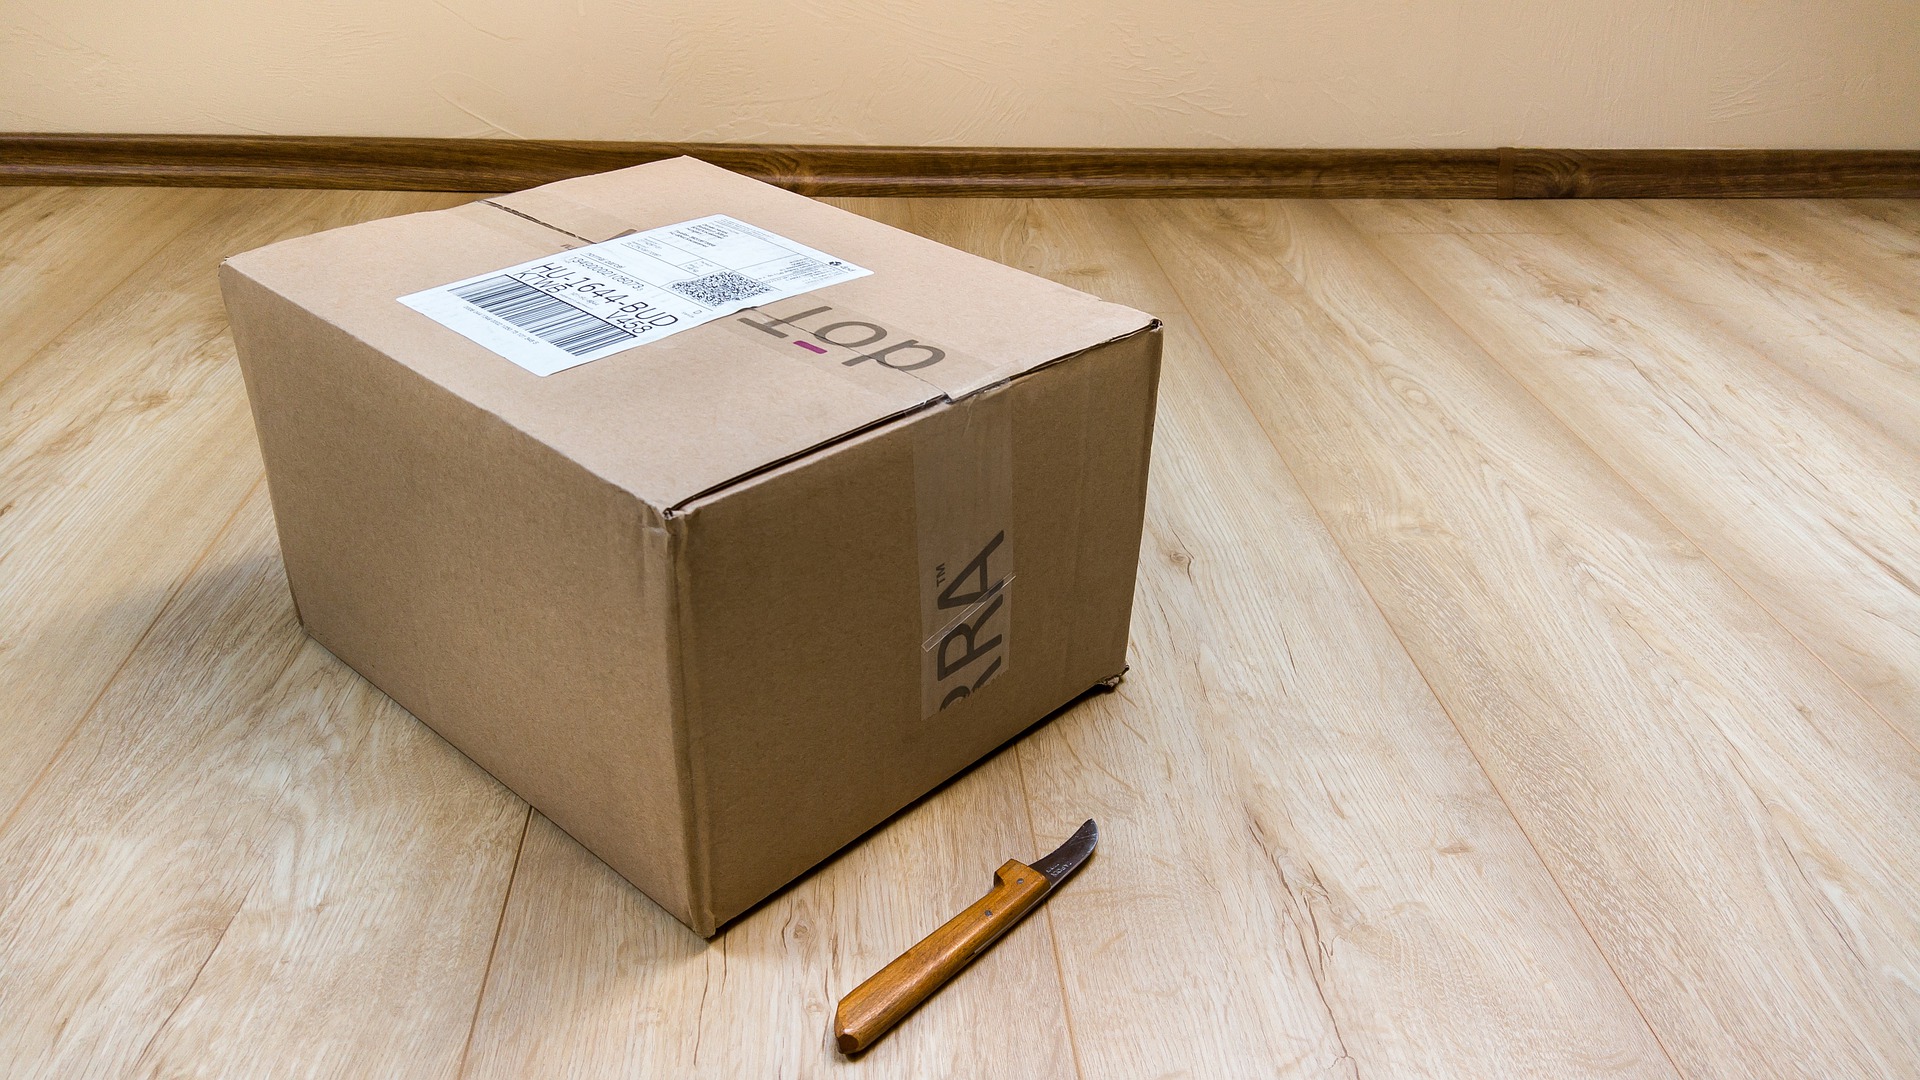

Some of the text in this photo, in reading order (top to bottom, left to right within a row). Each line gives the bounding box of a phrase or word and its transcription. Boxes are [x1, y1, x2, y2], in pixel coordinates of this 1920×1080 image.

[513, 269, 568, 294] KTWB
[531, 262, 679, 327] HU-1644-BUD
[605, 310, 653, 334] V458
